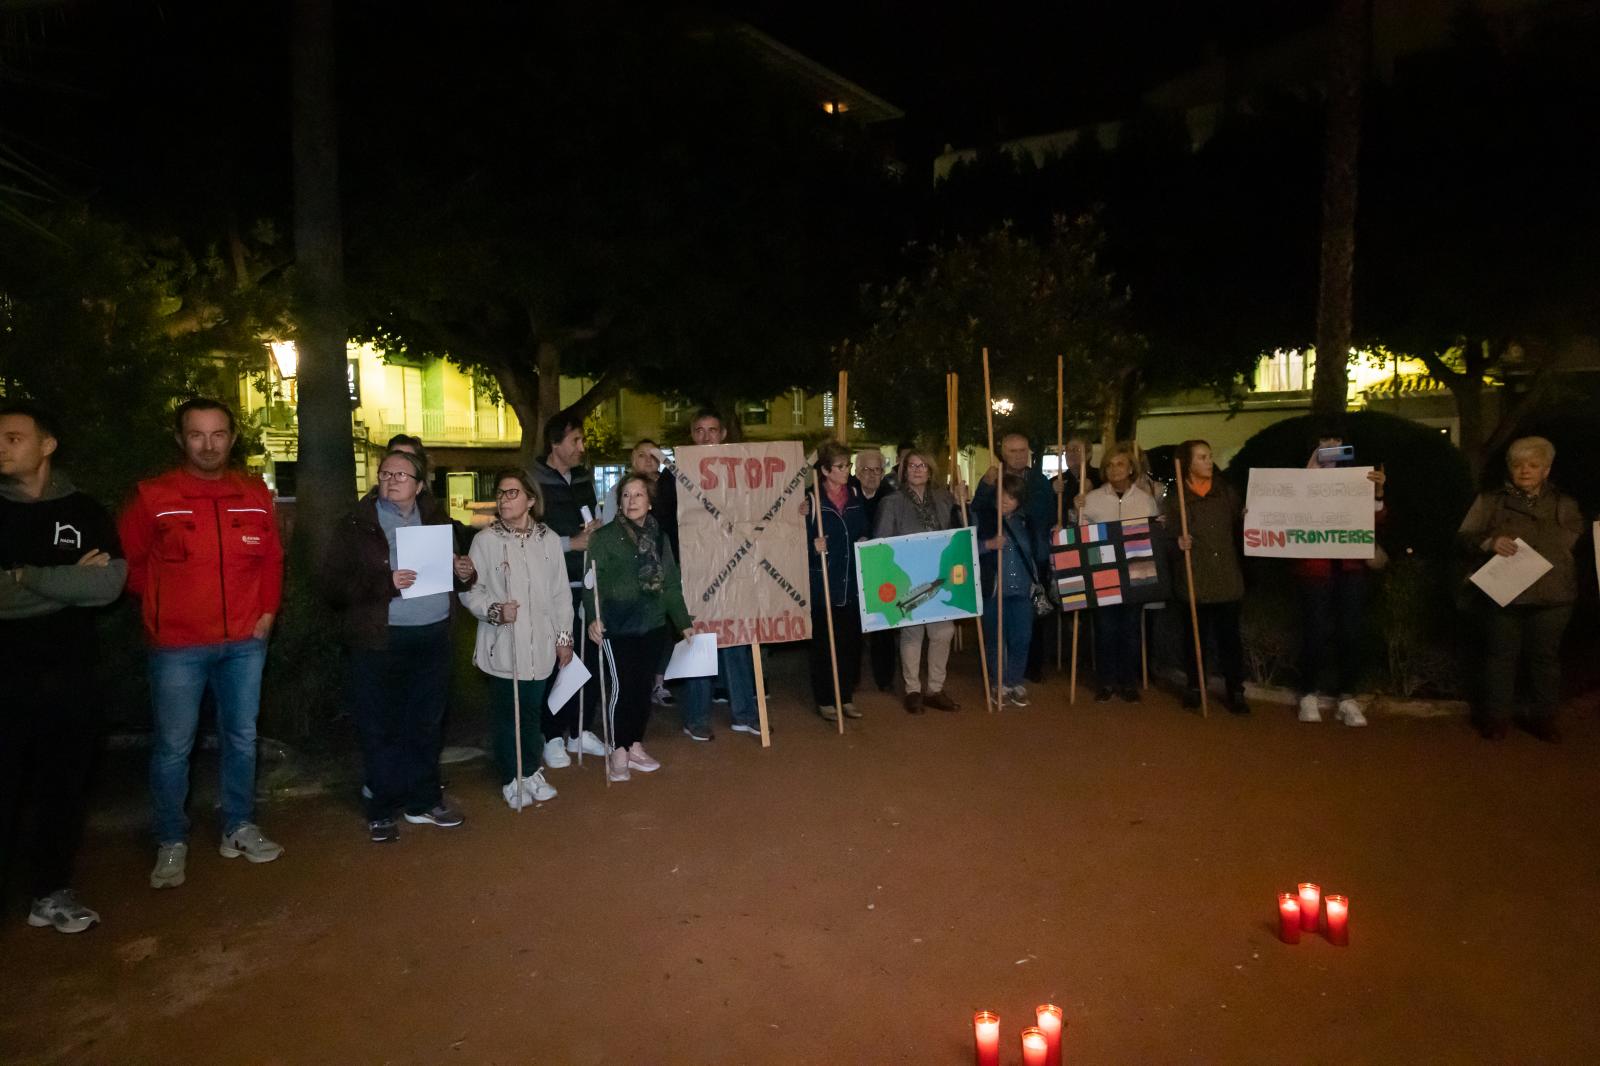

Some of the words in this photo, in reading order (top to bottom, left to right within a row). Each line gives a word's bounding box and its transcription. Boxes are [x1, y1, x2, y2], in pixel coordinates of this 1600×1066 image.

[699, 458, 786, 489] STOP
[1244, 528, 1286, 547] SIN
[759, 559, 806, 608] PRECINTADO
